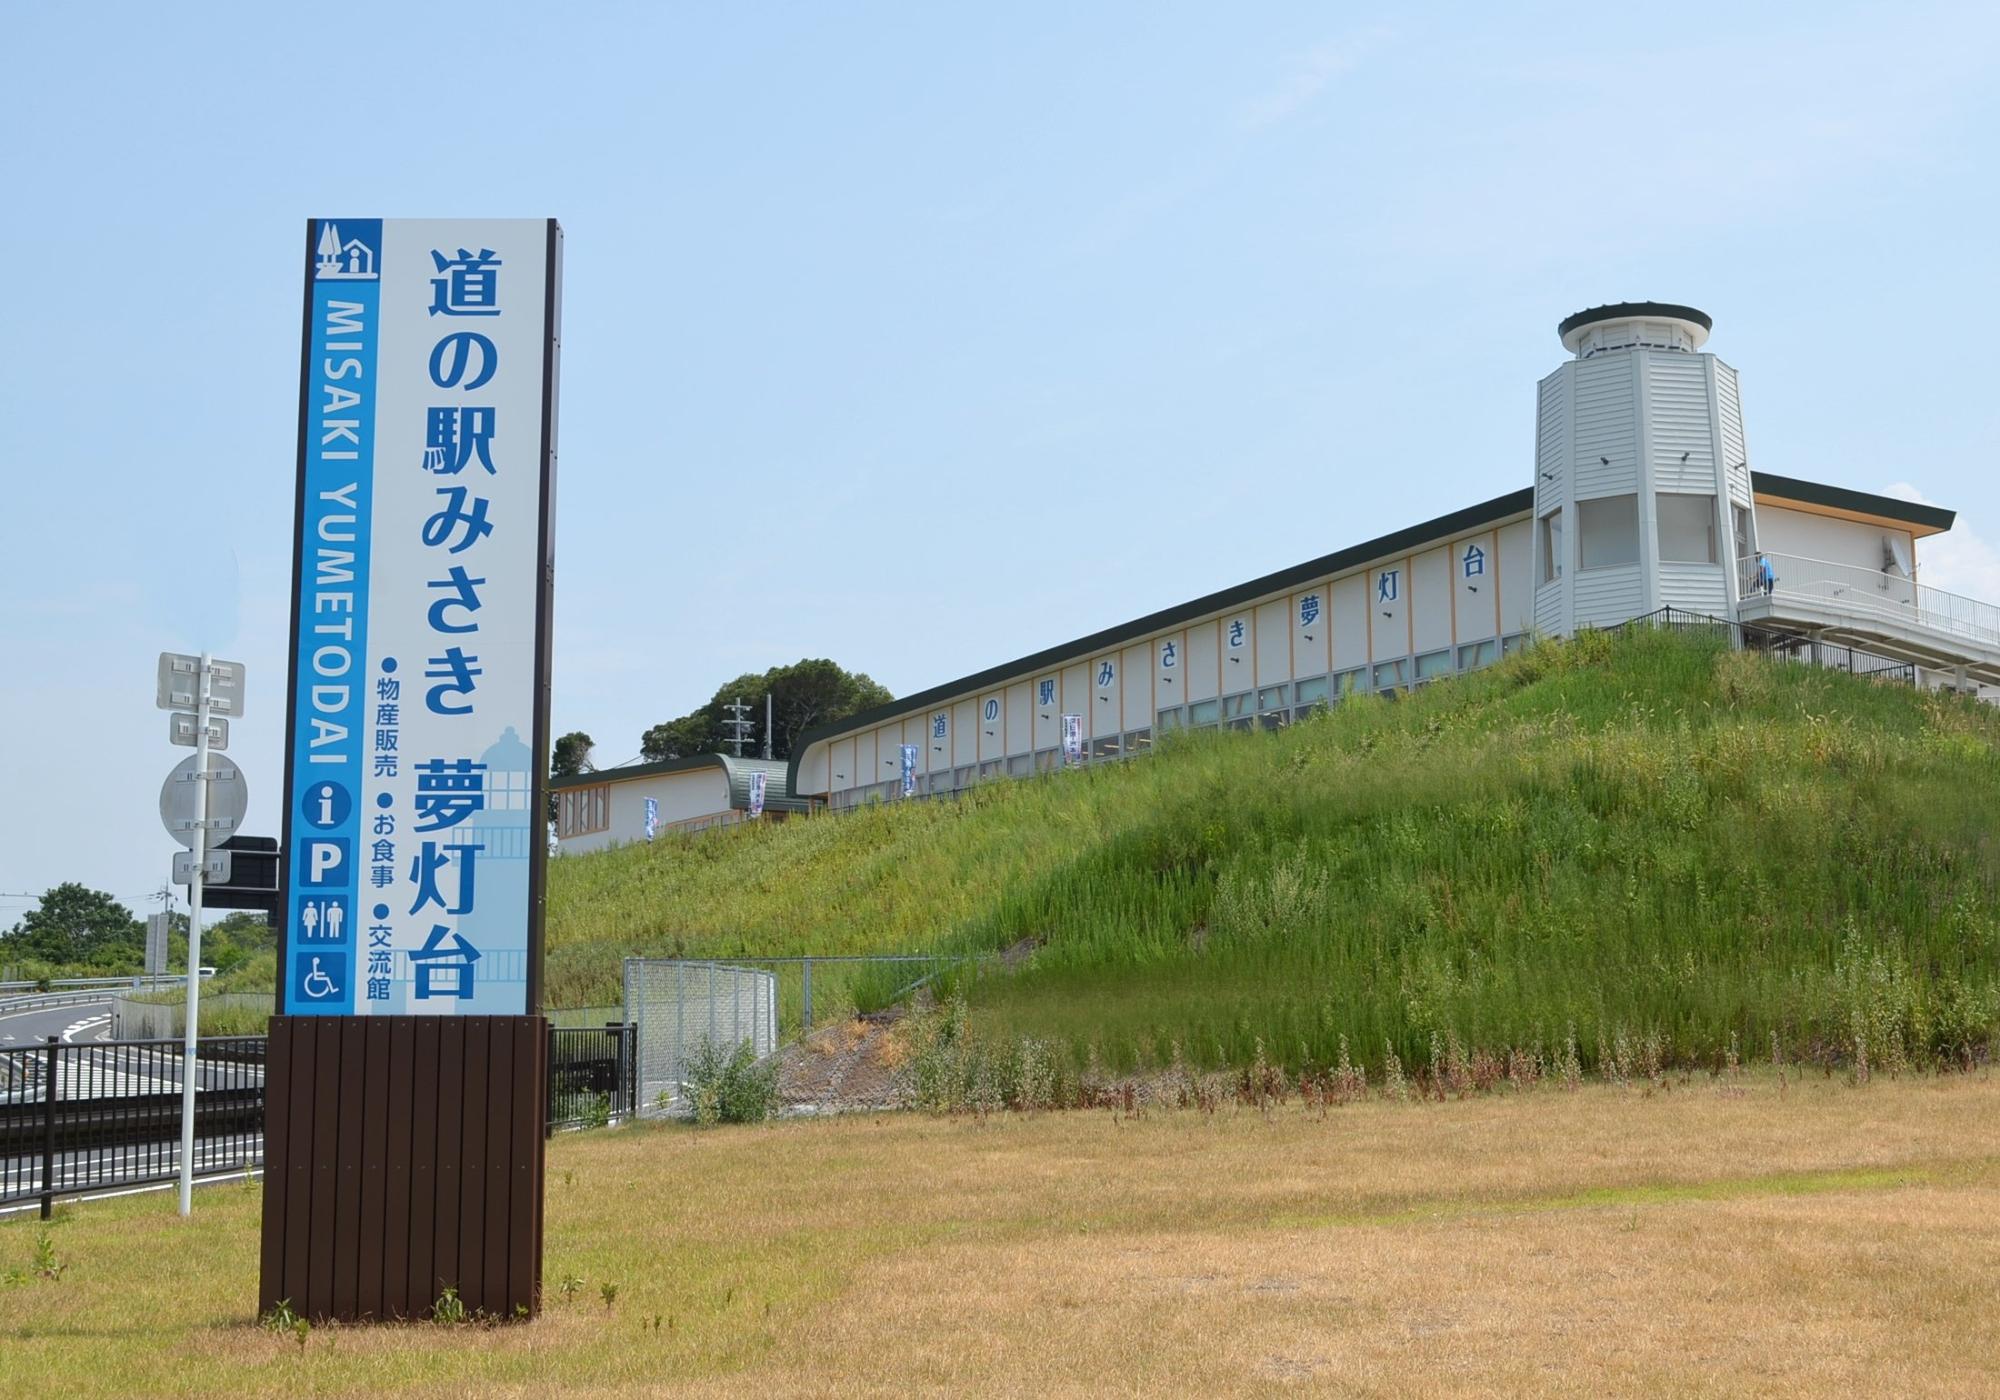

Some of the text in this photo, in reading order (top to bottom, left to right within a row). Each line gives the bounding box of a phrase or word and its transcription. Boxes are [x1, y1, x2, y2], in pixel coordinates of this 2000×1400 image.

[309, 300, 364, 763] MISAKI YUMETODAI
[374, 677, 400, 778] 物産販売
[310, 843, 342, 882] P
[370, 813, 395, 889] お食事
[367, 924, 393, 1000] 交流館
